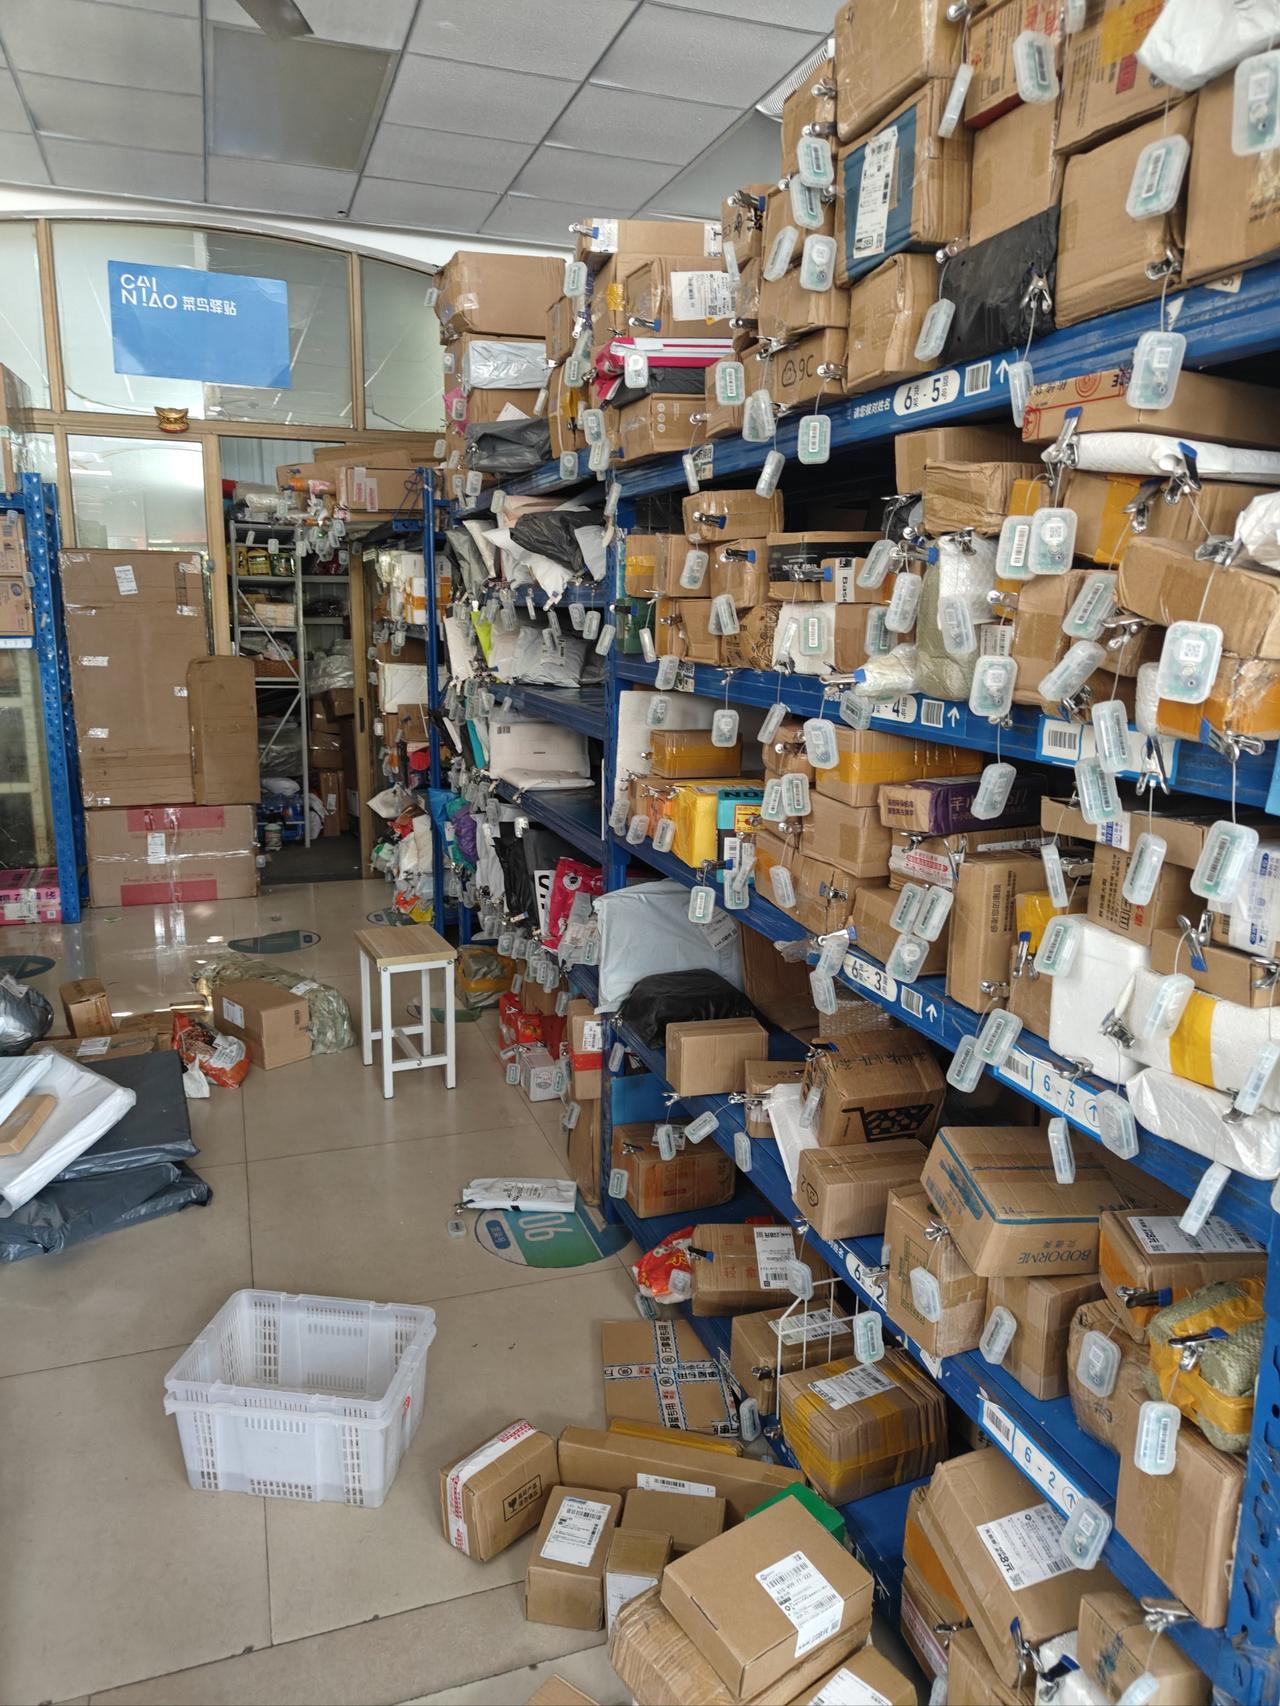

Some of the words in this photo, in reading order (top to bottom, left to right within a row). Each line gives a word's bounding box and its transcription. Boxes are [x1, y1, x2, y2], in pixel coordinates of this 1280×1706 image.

[120, 273, 157, 292] CAI
[182, 295, 237, 316] 菜鸟驿站
[904, 386, 913, 411] 6
[931, 377, 941, 402] 5
[851, 960, 859, 979] 6
[874, 971, 882, 991] 3
